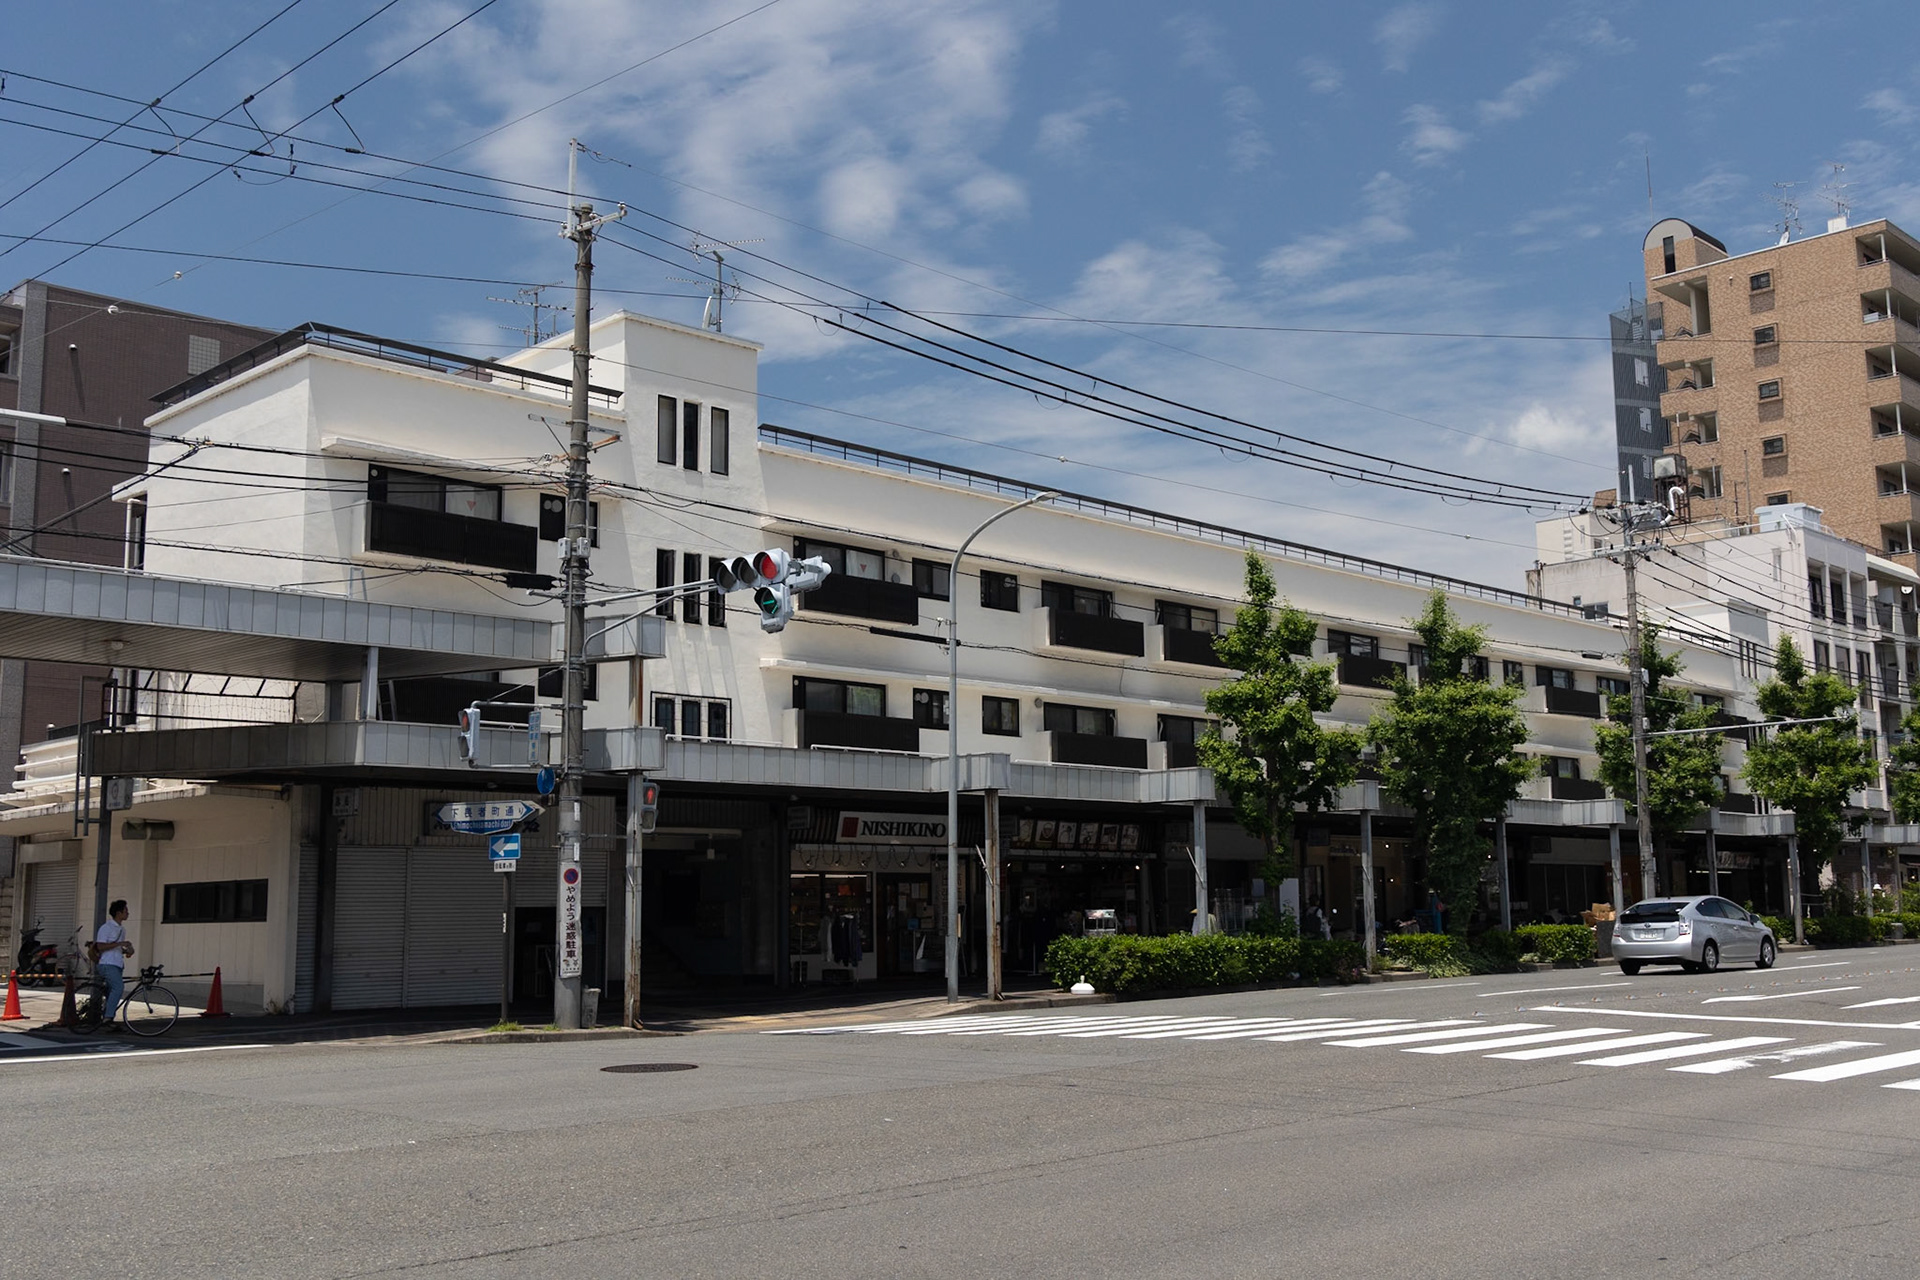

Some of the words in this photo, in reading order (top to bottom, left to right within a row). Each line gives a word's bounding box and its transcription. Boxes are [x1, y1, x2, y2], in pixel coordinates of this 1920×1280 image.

[451, 805, 524, 818] 下長者町通り
[860, 820, 947, 838] NISHIKINO
[565, 886, 577, 959] やめよう迷惑駐車
